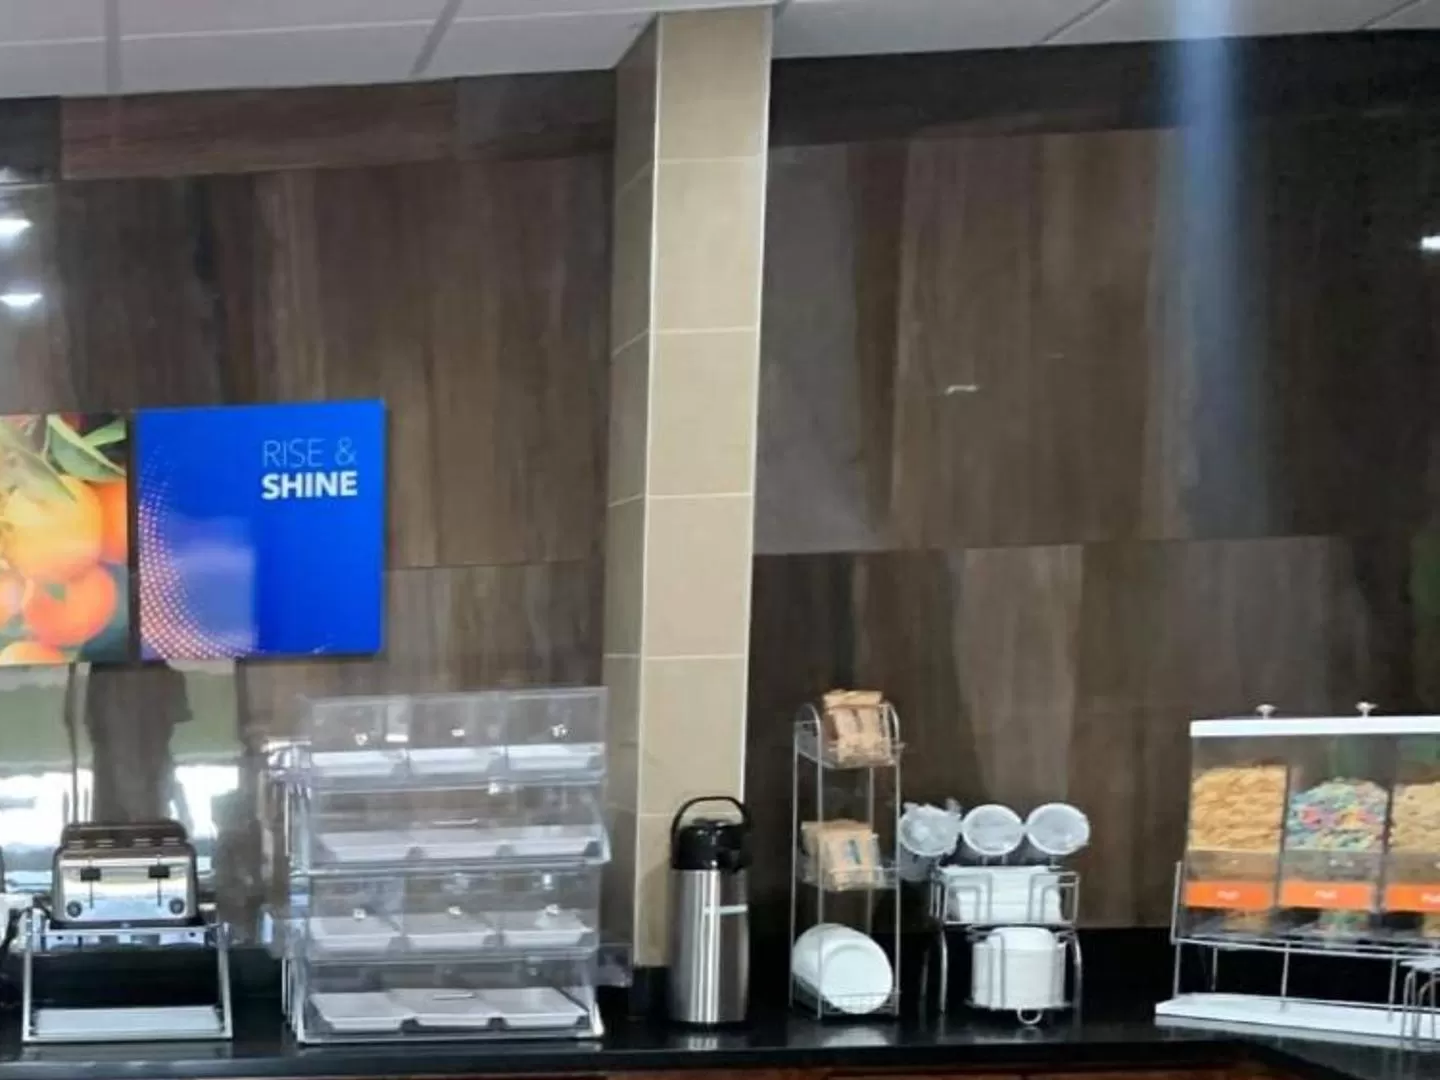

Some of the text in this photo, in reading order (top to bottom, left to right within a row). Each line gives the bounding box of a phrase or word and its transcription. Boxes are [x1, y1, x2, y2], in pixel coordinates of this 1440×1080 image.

[263, 436, 357, 468] RISE &
[261, 470, 358, 500] SHINE
